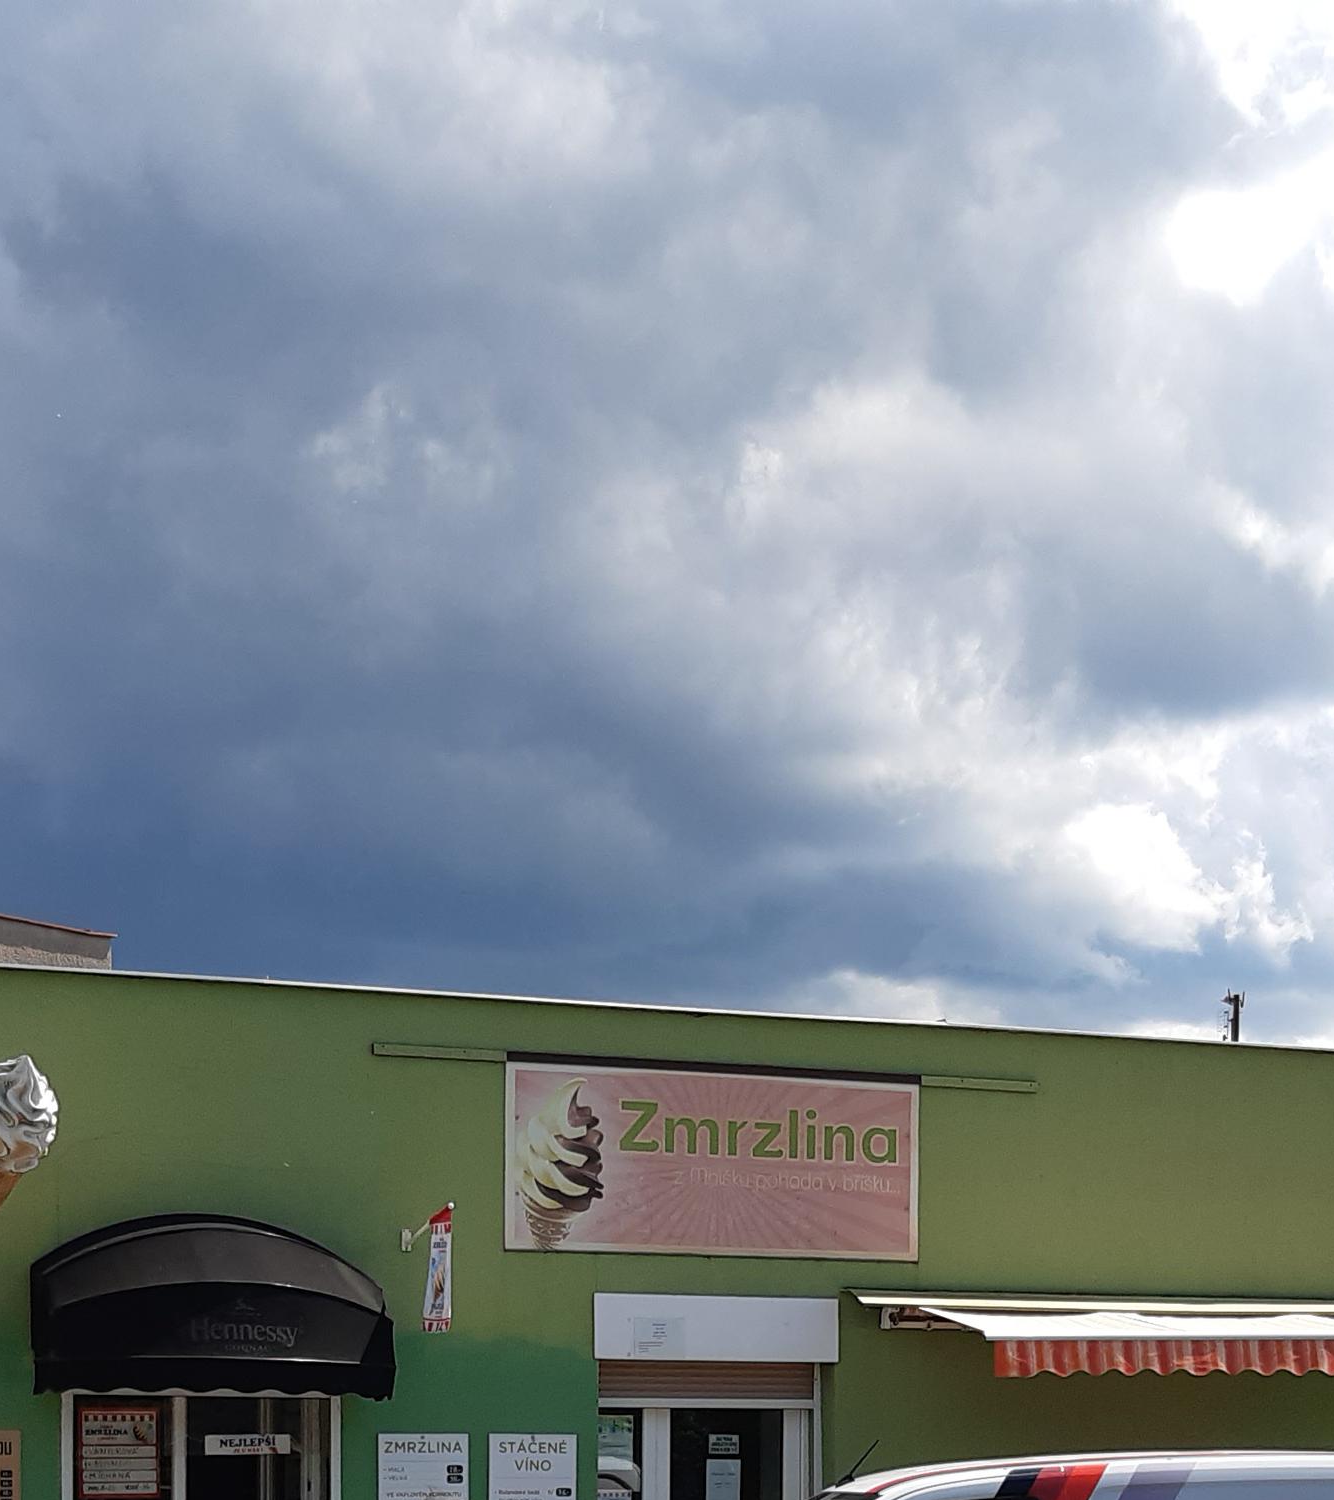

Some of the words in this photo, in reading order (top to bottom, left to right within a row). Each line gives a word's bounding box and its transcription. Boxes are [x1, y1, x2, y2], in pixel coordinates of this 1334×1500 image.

[619, 1099, 898, 1165] Zmrzlina
[828, 1177, 837, 1192] v
[189, 1317, 299, 1348] Hennessy
[219, 1435, 276, 1448] NEJLEPŠÍ
[384, 1441, 463, 1454] ZMRZLINA
[498, 1439, 567, 1454] STÁČENÉ
[514, 1457, 552, 1472] VÍNO
